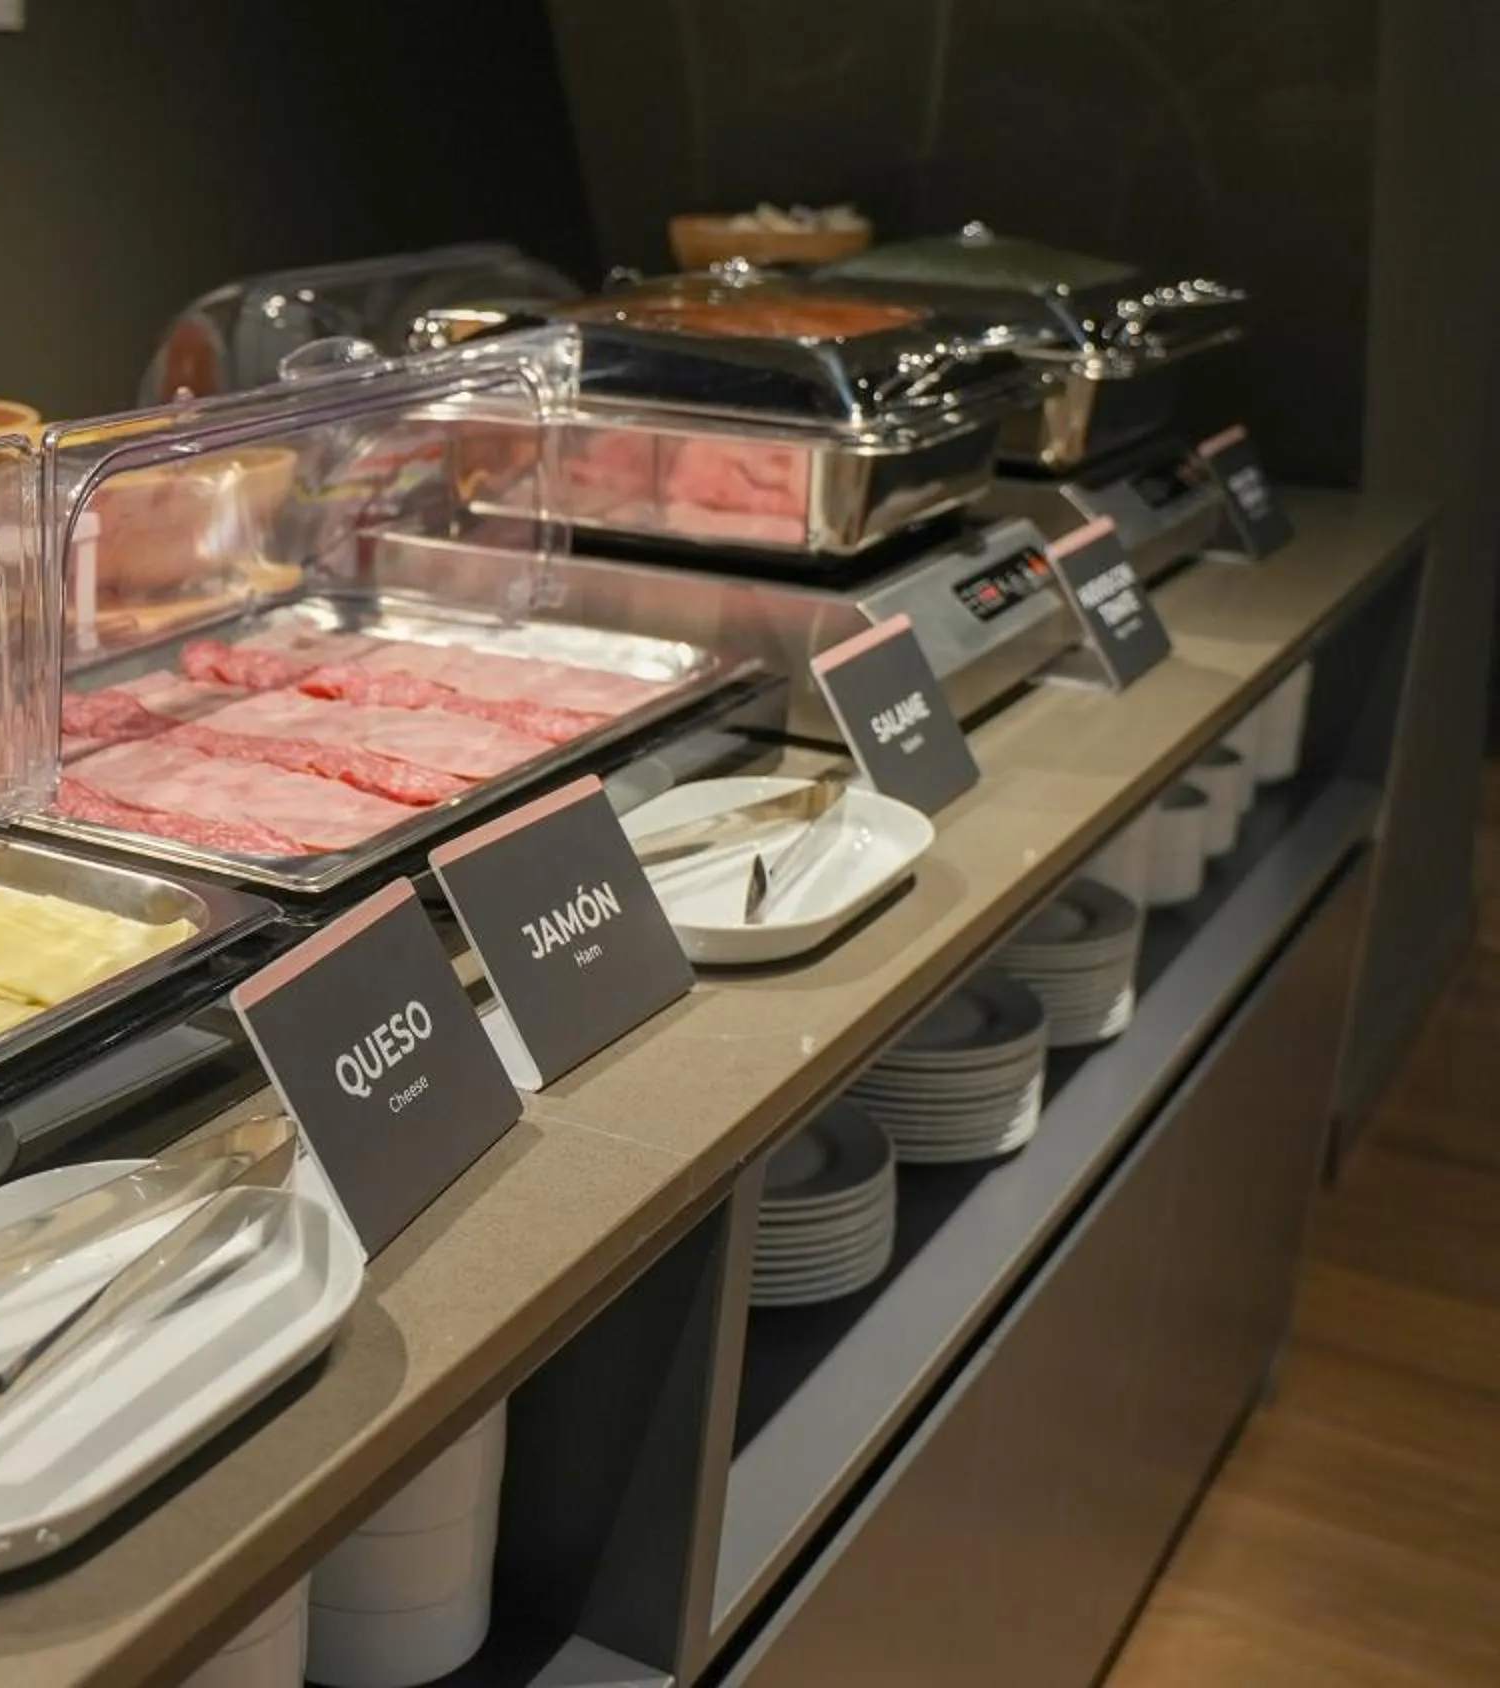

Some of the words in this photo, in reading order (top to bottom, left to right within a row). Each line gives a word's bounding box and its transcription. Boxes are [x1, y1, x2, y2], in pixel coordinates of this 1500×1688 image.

[521, 881, 621, 959] JAMÓN
[573, 944, 603, 968] Ham
[335, 1000, 432, 1098] QUESO
[389, 1075, 429, 1113] Cheese
